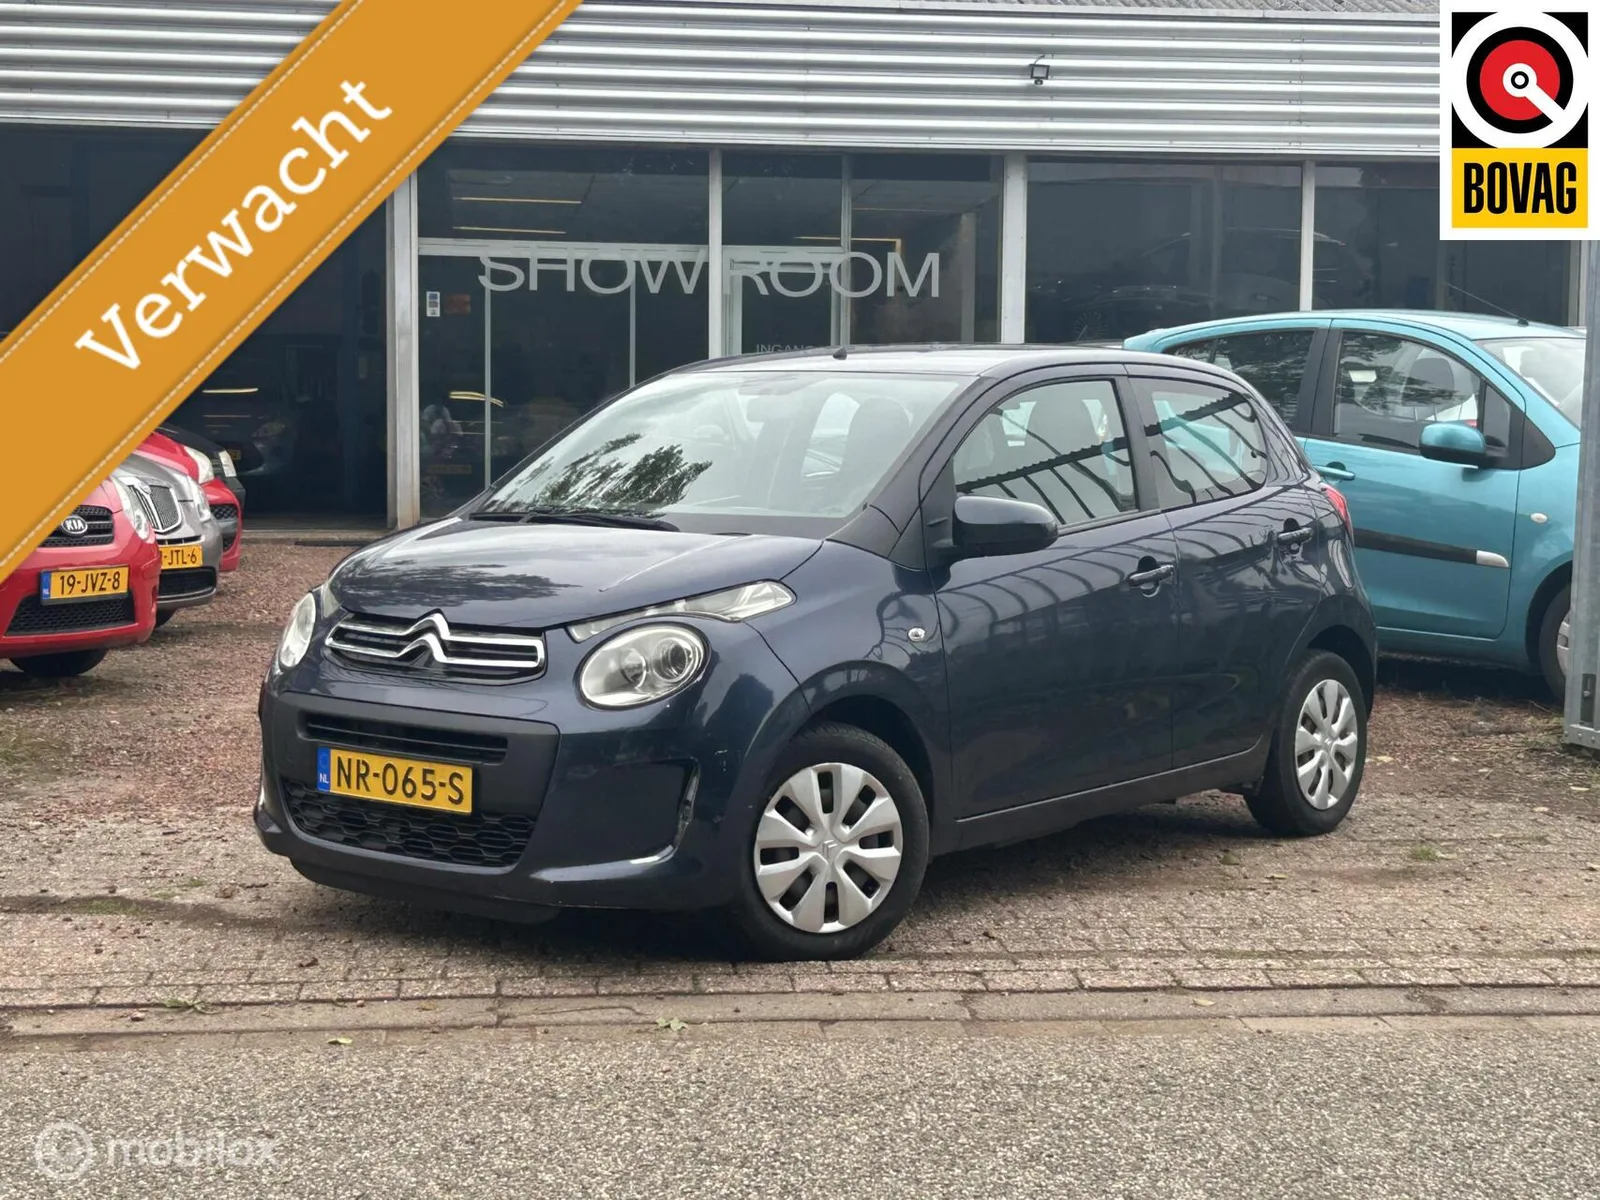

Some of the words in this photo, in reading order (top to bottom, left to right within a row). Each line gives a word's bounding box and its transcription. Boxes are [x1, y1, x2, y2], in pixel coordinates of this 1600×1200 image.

[65, 519, 85, 531] KIA
[59, 571, 121, 595] 19-JVZ-8
[319, 772, 330, 784] NL
[337, 756, 465, 805] NR-065-S
